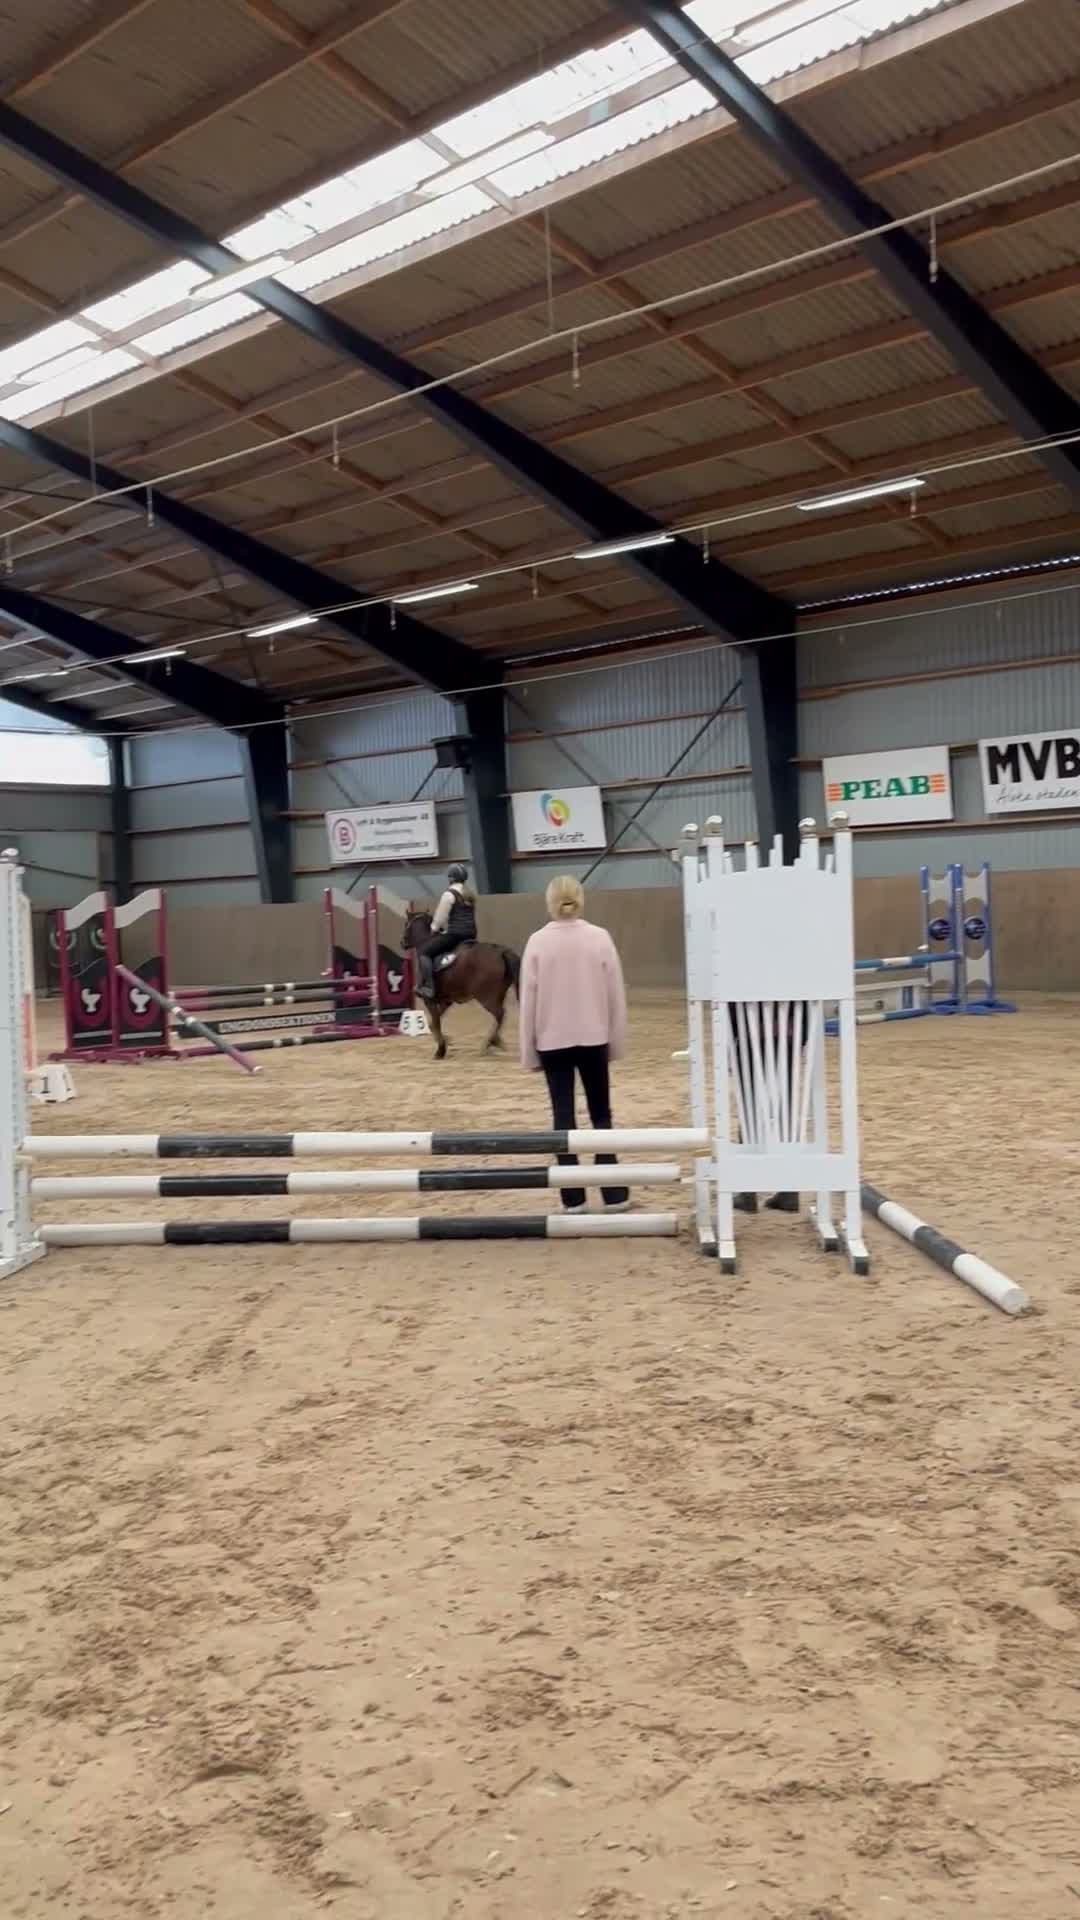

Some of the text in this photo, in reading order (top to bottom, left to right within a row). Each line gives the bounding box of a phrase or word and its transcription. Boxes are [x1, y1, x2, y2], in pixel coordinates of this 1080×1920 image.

[987, 738, 1080, 785] MVB
[841, 776, 930, 801] PEAB
[403, 1016, 411, 1030] 5
[417, 1016, 425, 1030] 5
[40, 1076, 51, 1094] 1
